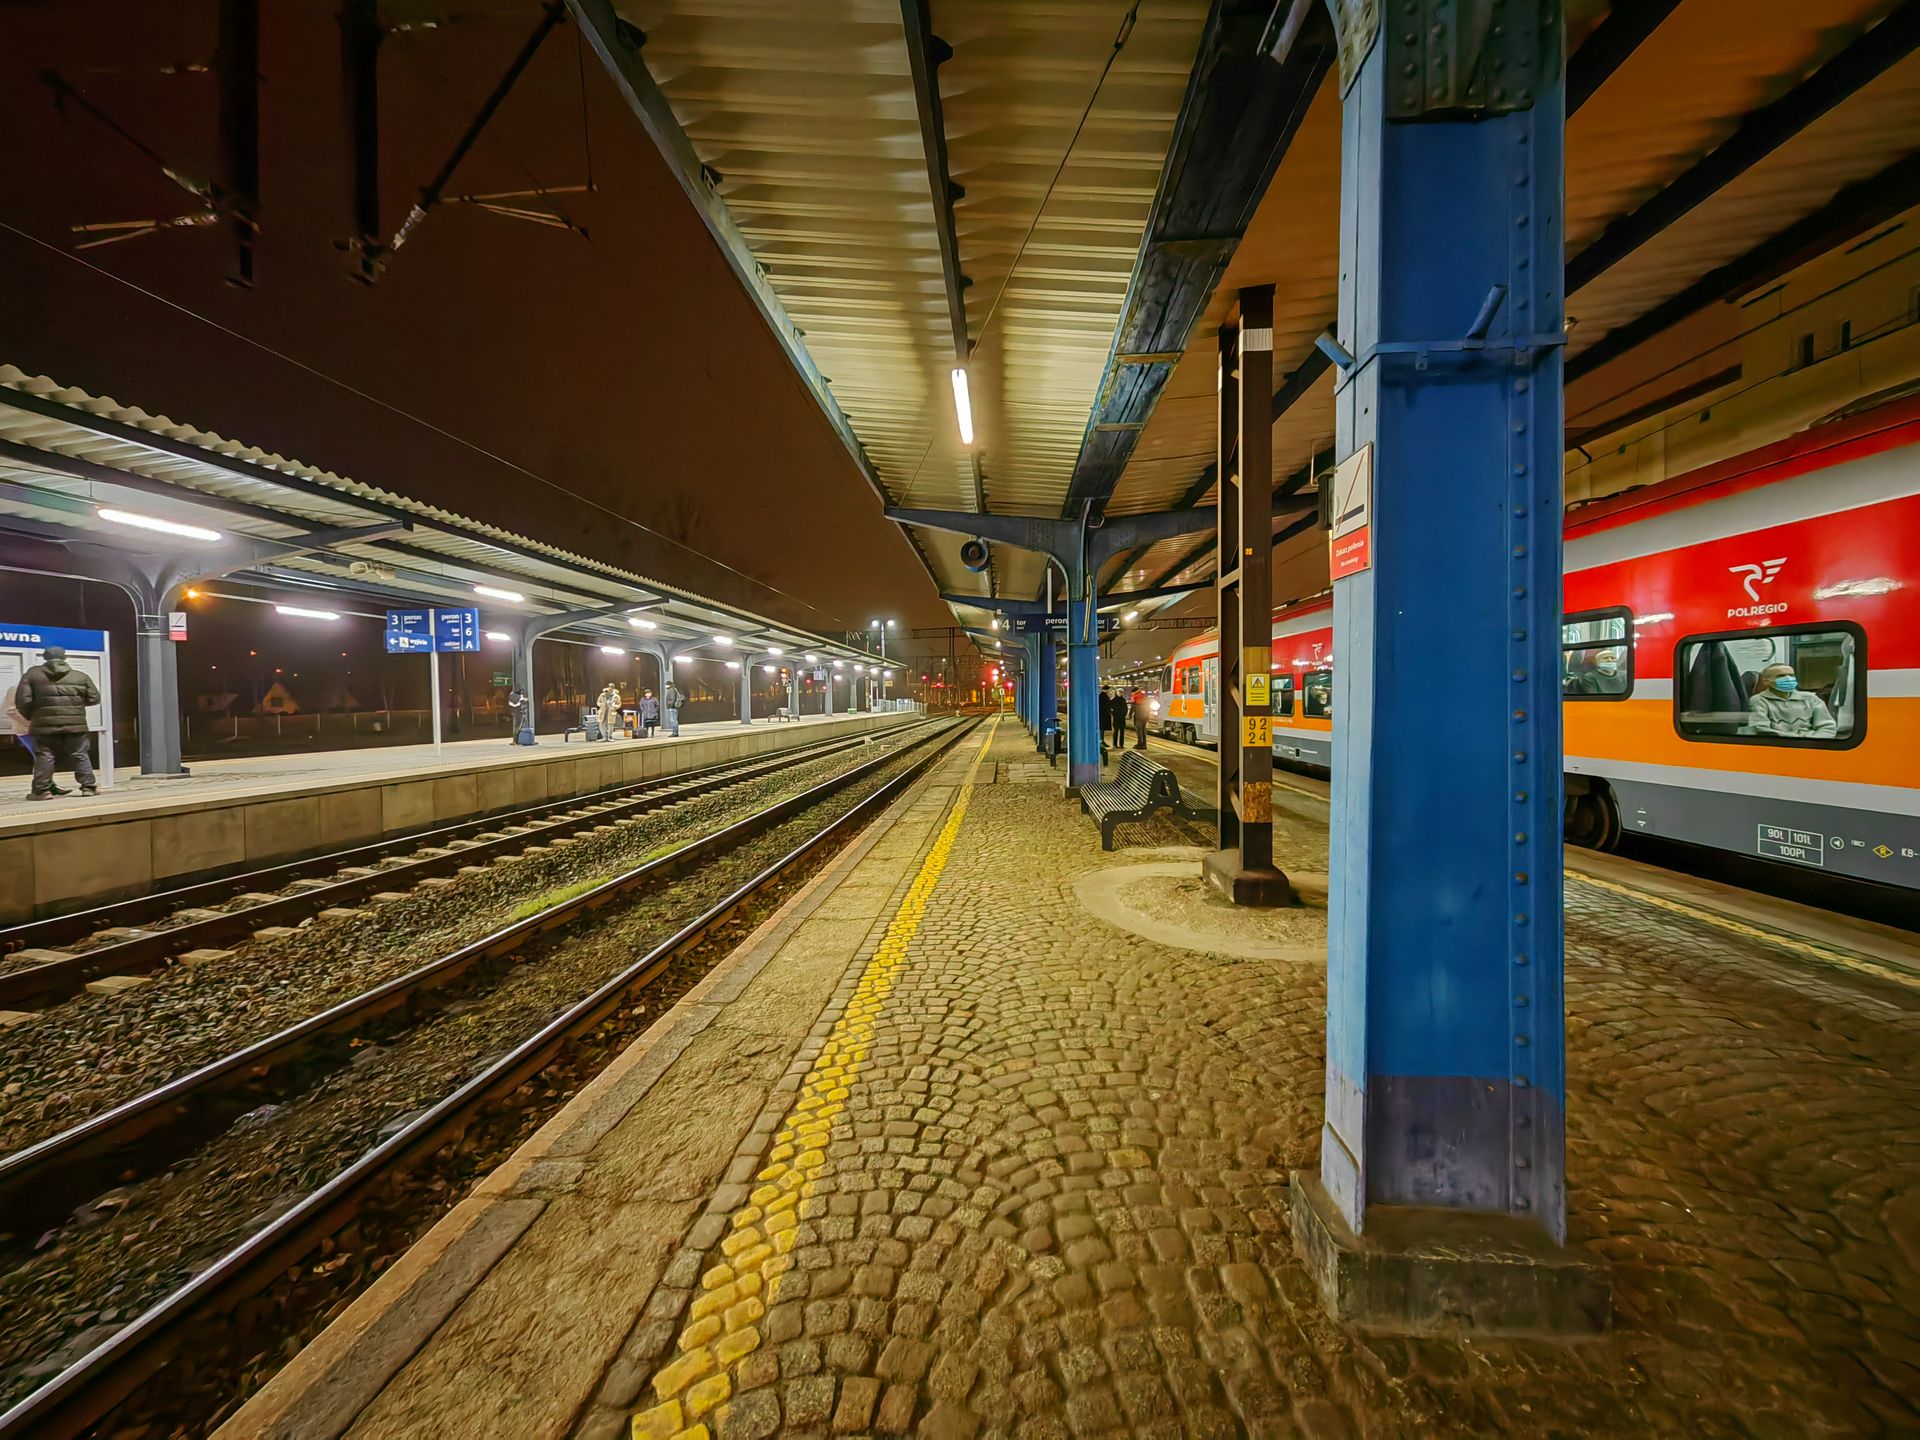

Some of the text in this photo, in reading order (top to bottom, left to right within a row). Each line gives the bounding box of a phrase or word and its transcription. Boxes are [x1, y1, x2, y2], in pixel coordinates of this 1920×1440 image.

[1727, 602, 1788, 618] POLREGIO
[391, 615, 399, 625] 3
[464, 613, 472, 624] 3
[1045, 618, 1068, 626] peron
[1112, 618, 1121, 630] 2
[1002, 619, 1011, 631] 4
[465, 627, 472, 636] 6
[0, 632, 41, 643] wna
[465, 640, 473, 649] A
